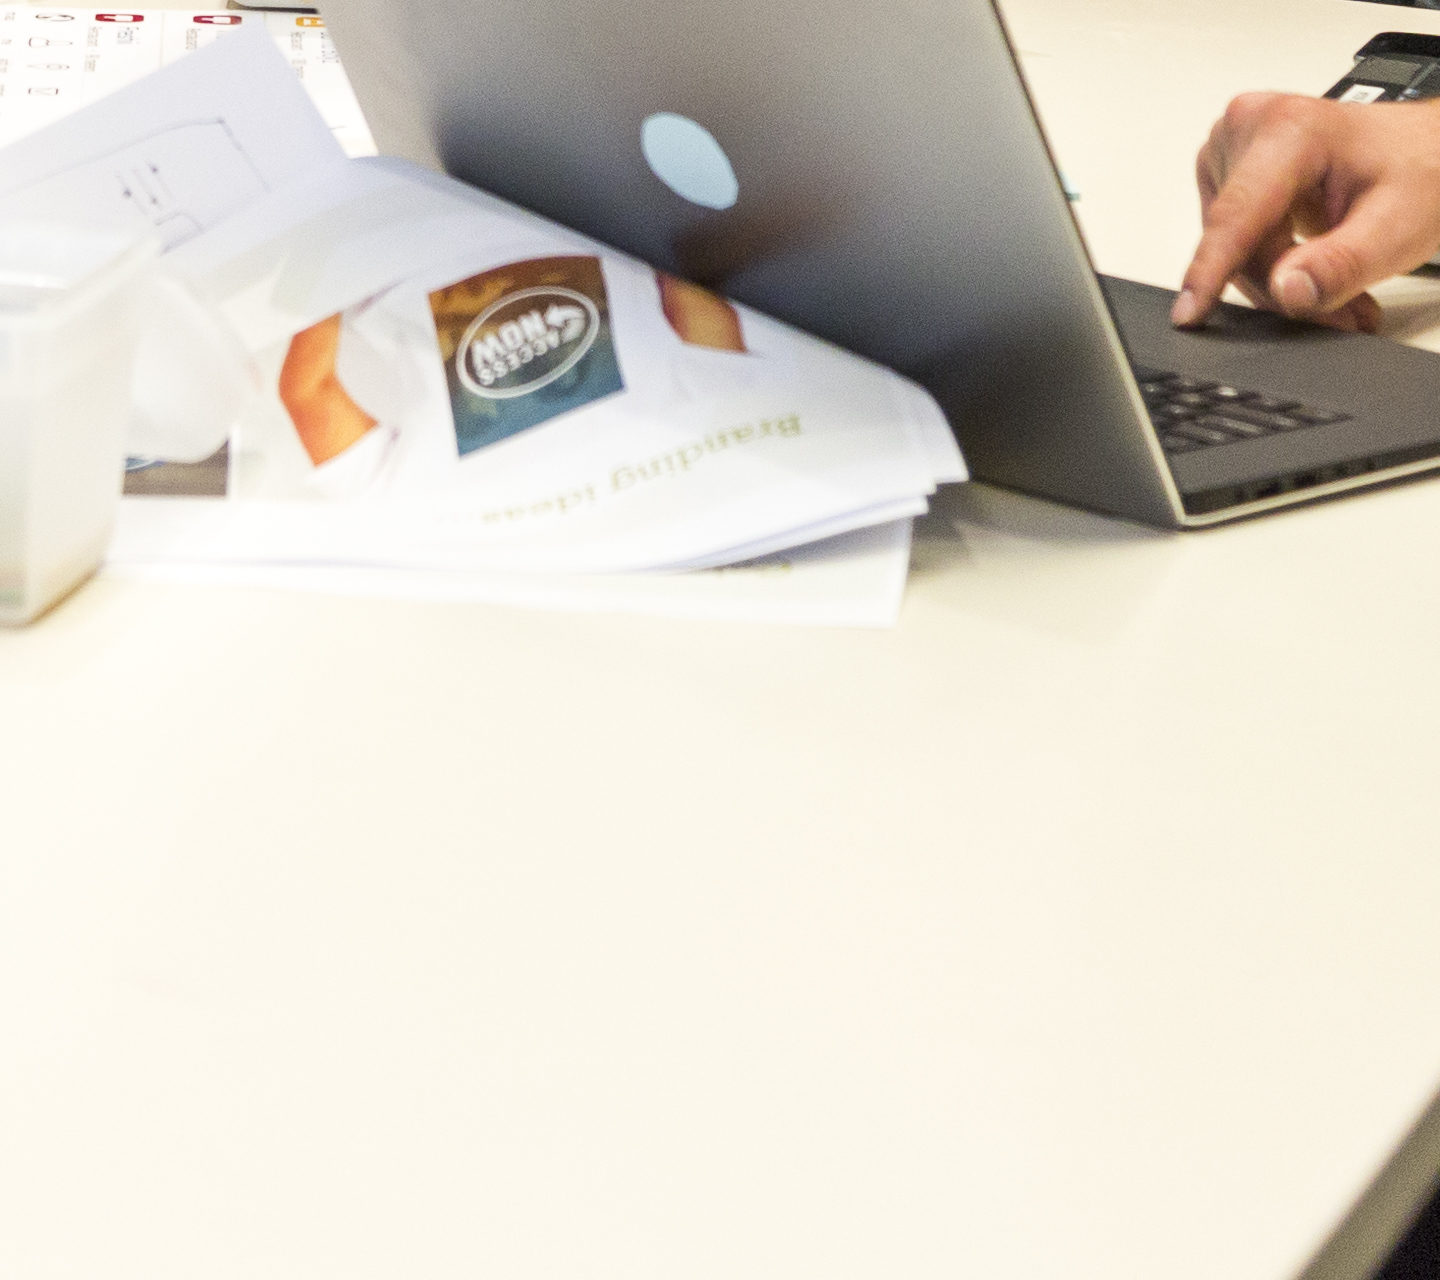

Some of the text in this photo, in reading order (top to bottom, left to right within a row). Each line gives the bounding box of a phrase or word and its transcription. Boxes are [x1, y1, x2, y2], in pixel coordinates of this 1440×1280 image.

[471, 309, 549, 372] NOW
[476, 327, 561, 386] ACCESS
[609, 412, 804, 494] Branding
